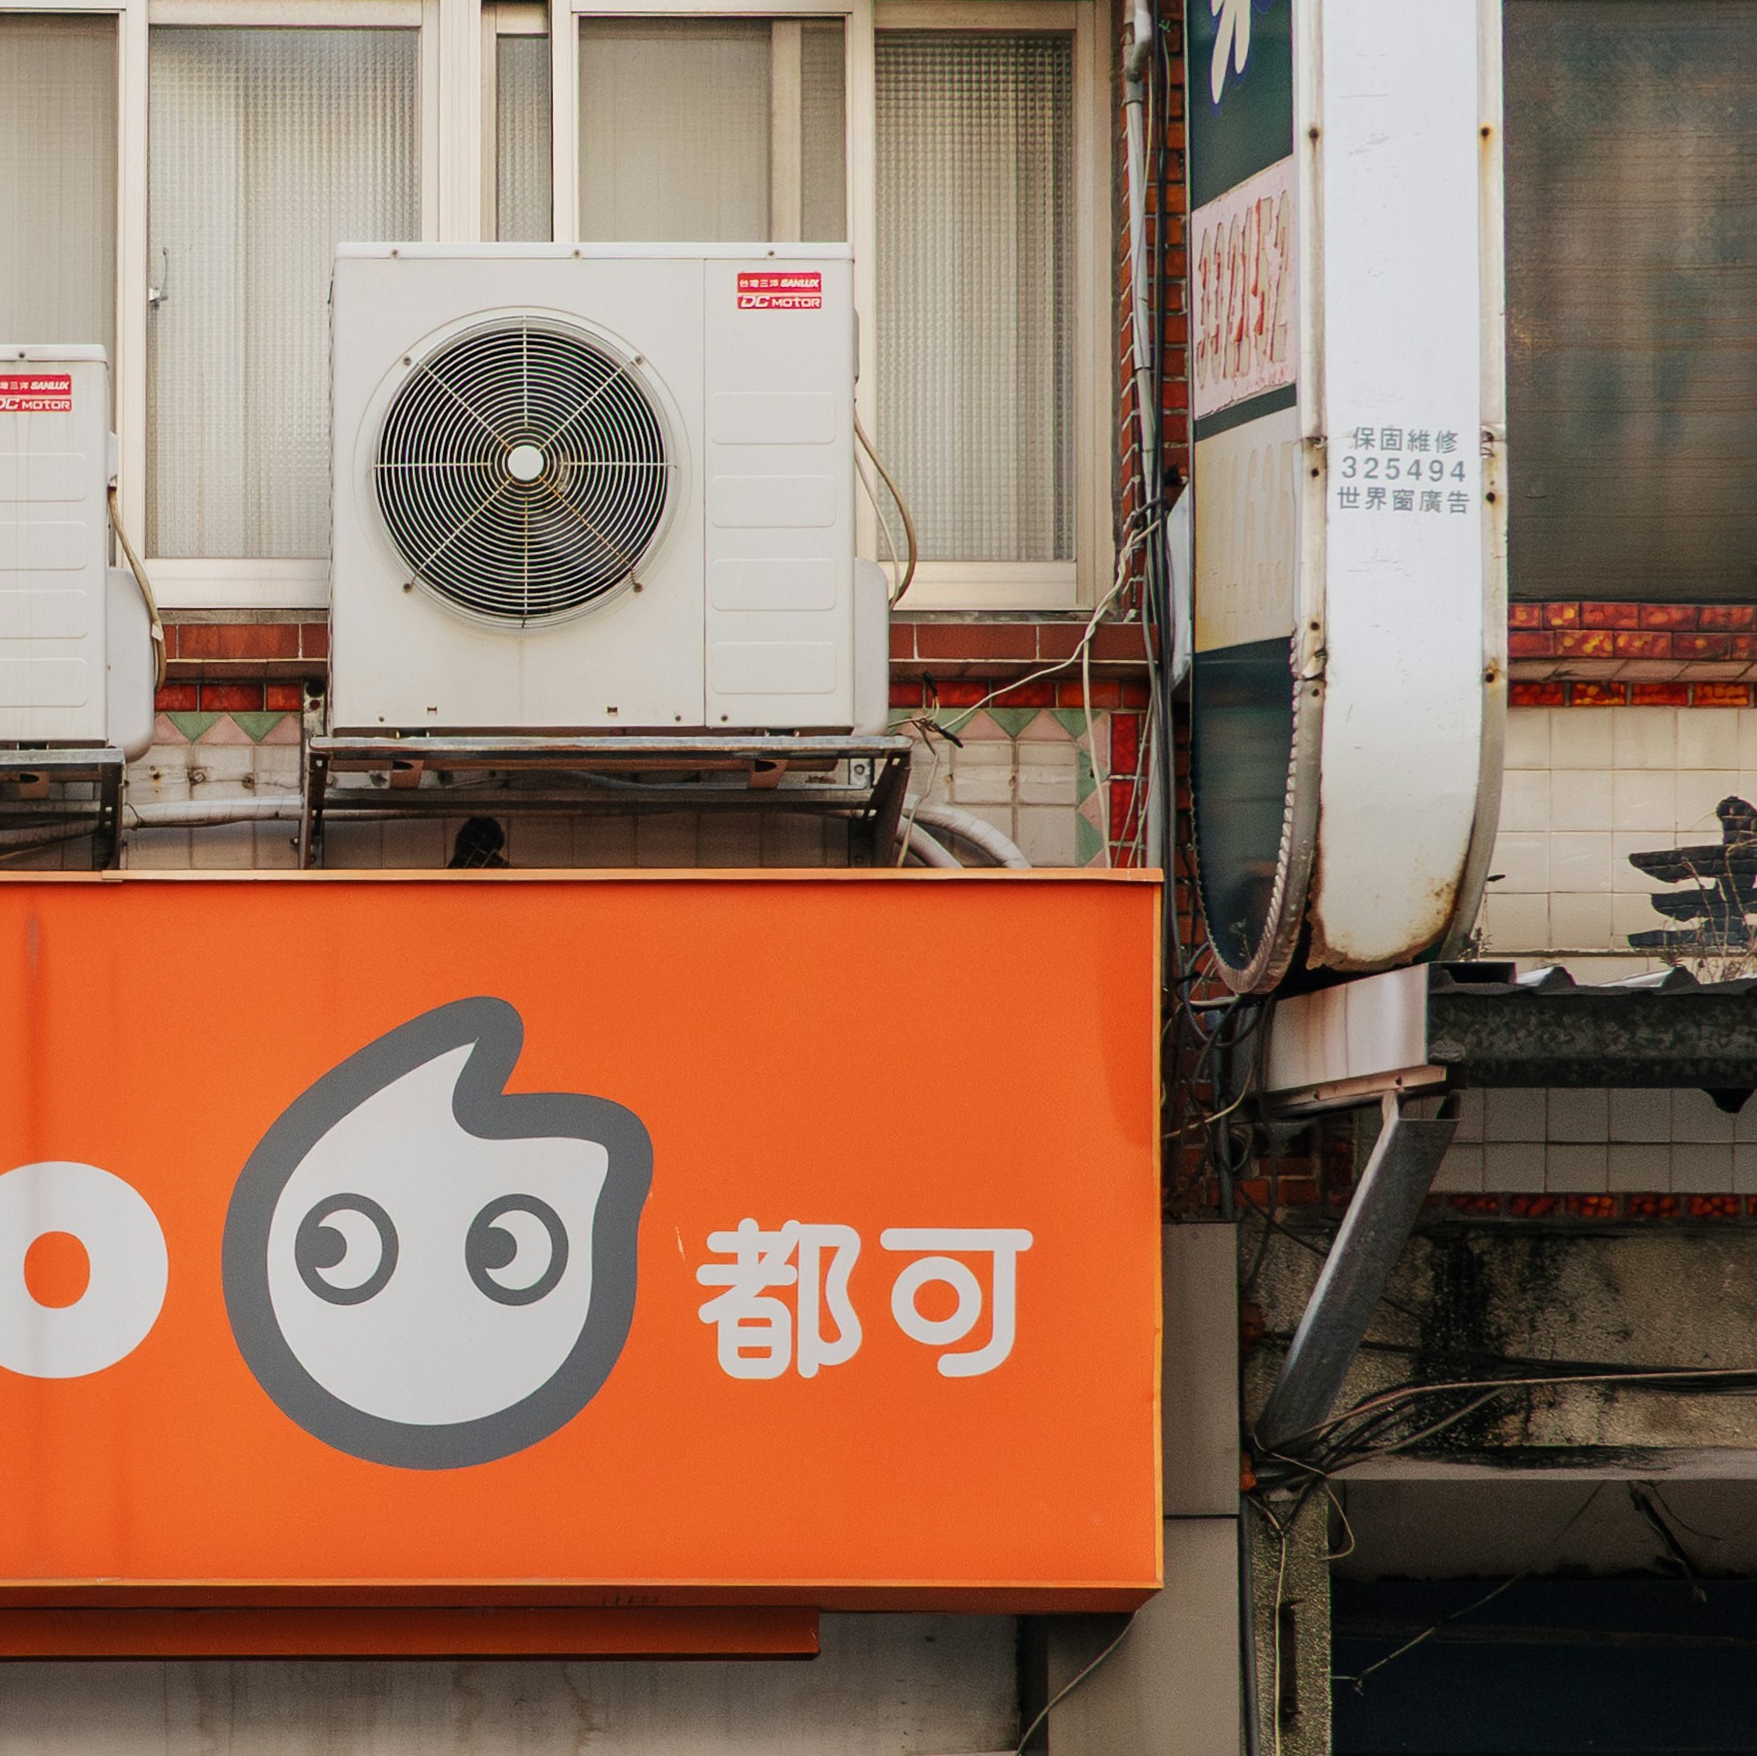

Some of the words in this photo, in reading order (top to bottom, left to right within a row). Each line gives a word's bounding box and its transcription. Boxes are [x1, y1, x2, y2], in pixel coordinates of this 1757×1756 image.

[741, 295, 770, 308] DC
[772, 298, 821, 308] MOTOR
[22, 400, 71, 410] MOTOR
[1352, 426, 1459, 454] 保固維修
[1342, 456, 1466, 483] 325494
[696, 1217, 1034, 1379] 都可
